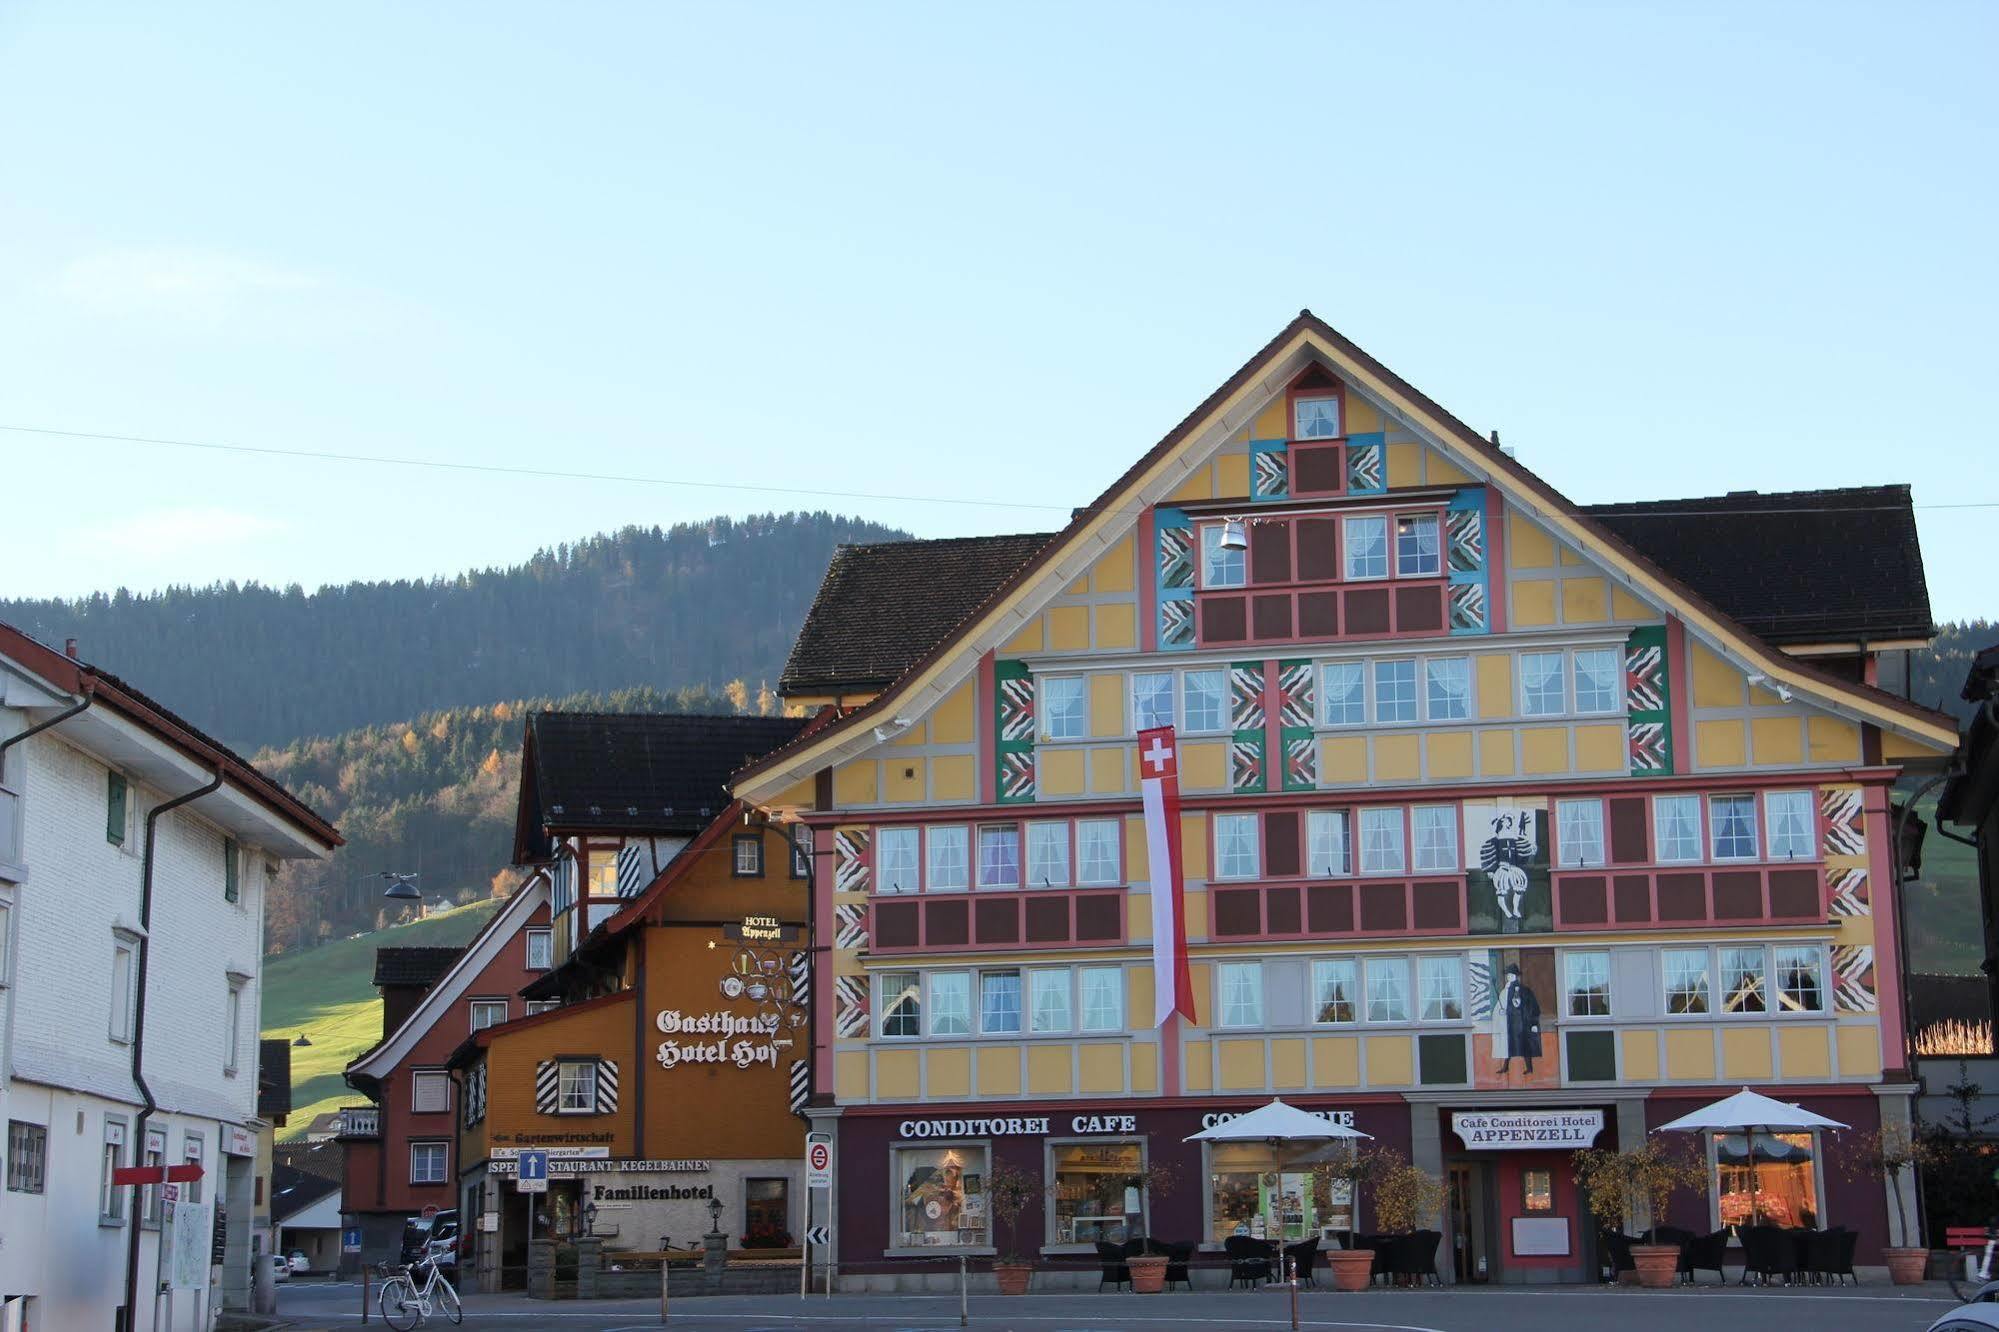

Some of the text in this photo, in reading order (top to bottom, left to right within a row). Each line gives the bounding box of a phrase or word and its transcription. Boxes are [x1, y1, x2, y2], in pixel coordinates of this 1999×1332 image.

[745, 917, 778, 927] HOTEL
[742, 926, 781, 940] Appenzell
[656, 1040, 728, 1069] Hotel
[899, 1118, 1049, 1138] CONDITOREI
[1071, 1115, 1136, 1133] CAFE
[1460, 1116, 1596, 1128] Cafe Conditorei Hotel
[515, 1132, 615, 1144] Gartenwirtschaft
[1472, 1128, 1585, 1142] APPENZELL
[621, 1159, 711, 1171] KEGELBAHNEN
[594, 1184, 714, 1200] Familienhotel
